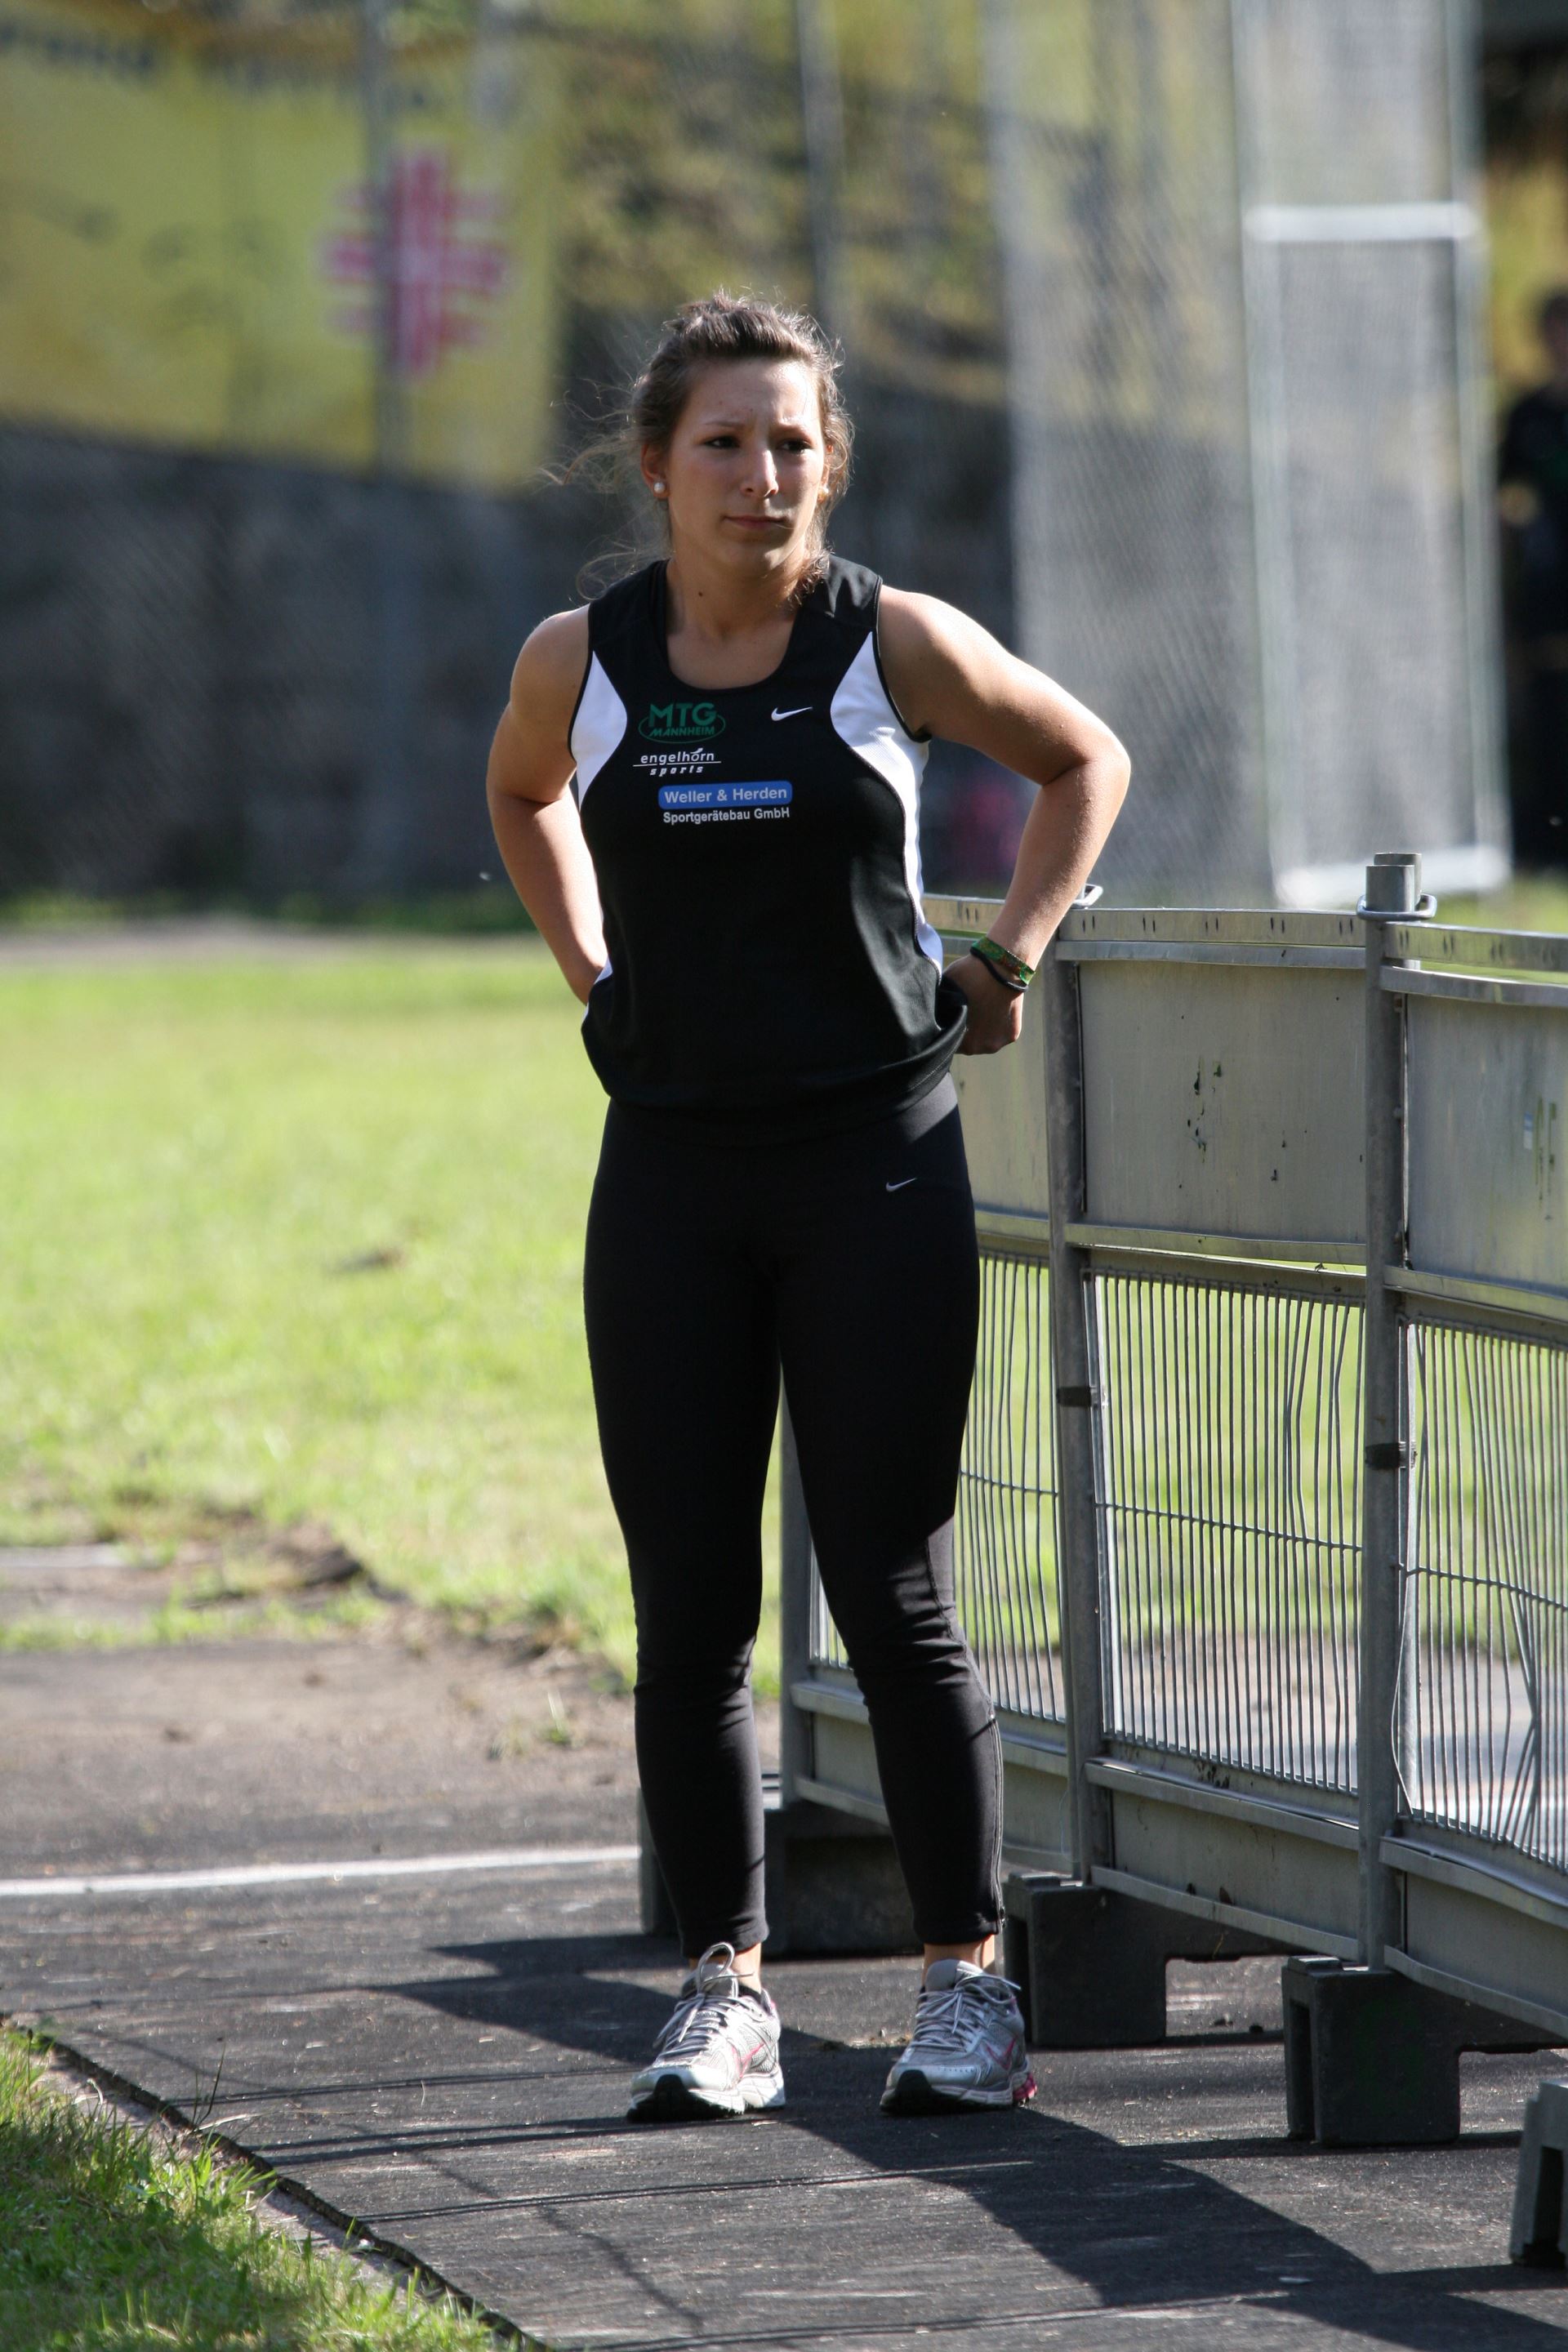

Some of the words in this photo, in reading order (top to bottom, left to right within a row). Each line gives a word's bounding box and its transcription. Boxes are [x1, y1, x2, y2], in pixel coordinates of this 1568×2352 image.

[649, 702, 716, 728] MTG
[651, 725, 715, 736] MANNHEIM
[640, 747, 715, 765] engelhorn
[650, 764, 703, 777] sports
[664, 791, 712, 804] Weller
[716, 790, 728, 802] &
[733, 786, 787, 800] Herden
[663, 810, 751, 825] Sportgerätebau
[754, 807, 790, 819] GmbH
